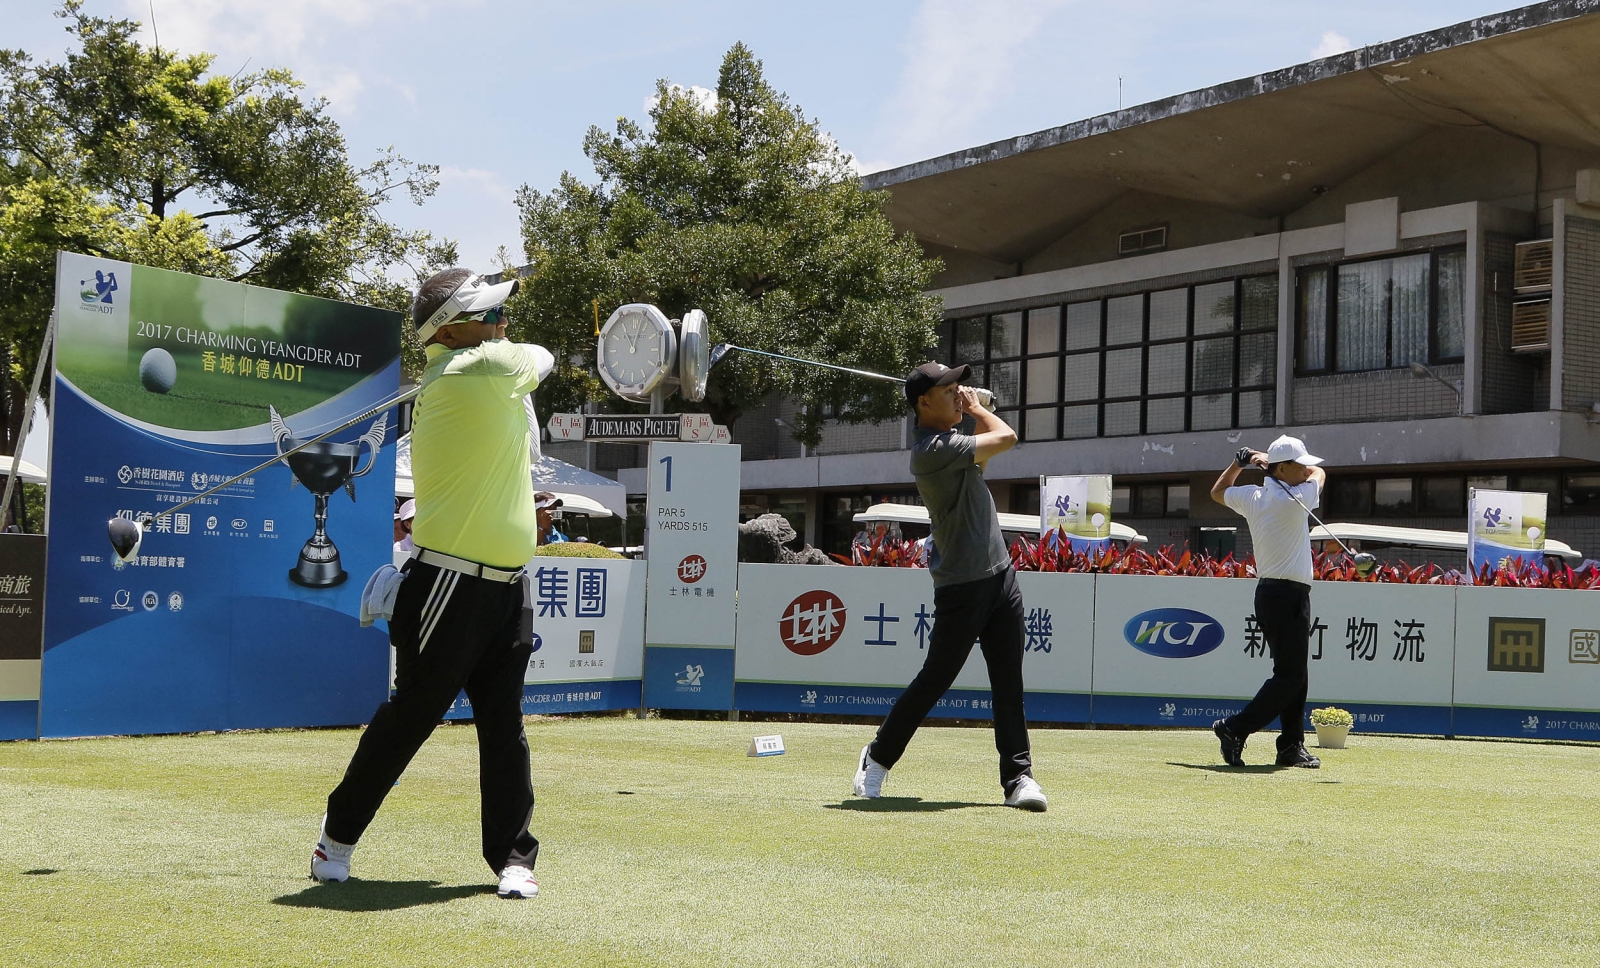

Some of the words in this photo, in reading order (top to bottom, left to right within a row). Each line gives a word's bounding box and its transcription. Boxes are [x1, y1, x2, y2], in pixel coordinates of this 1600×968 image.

[98, 306, 114, 314] ADT
[136, 320, 172, 340] 2017
[176, 326, 256, 352] CHARMING
[260, 340, 332, 365] YEANGDER
[334, 351, 362, 368] ADT
[202, 351, 304, 382] 香城仰德ADT
[588, 418, 642, 436] AUDEMARS
[643, 418, 680, 436] PIGUET
[562, 429, 570, 438] W
[692, 429, 699, 438] S
[660, 456, 672, 492] 1
[658, 508, 678, 517] PAR
[680, 508, 686, 518] 5
[658, 521, 690, 531] YARDS
[692, 522, 708, 532] 515
[534, 566, 608, 618] 集團
[669, 587, 715, 598] 士林電機
[864, 602, 1052, 654] 士林機
[1134, 620, 1214, 646] HCT
[1568, 629, 1600, 664] 國
[552, 694, 564, 702] ADT
[823, 695, 843, 704] 2017
[846, 696, 897, 706] CHARMING
[949, 700, 968, 708] ADT
[1182, 708, 1203, 716] 2017
